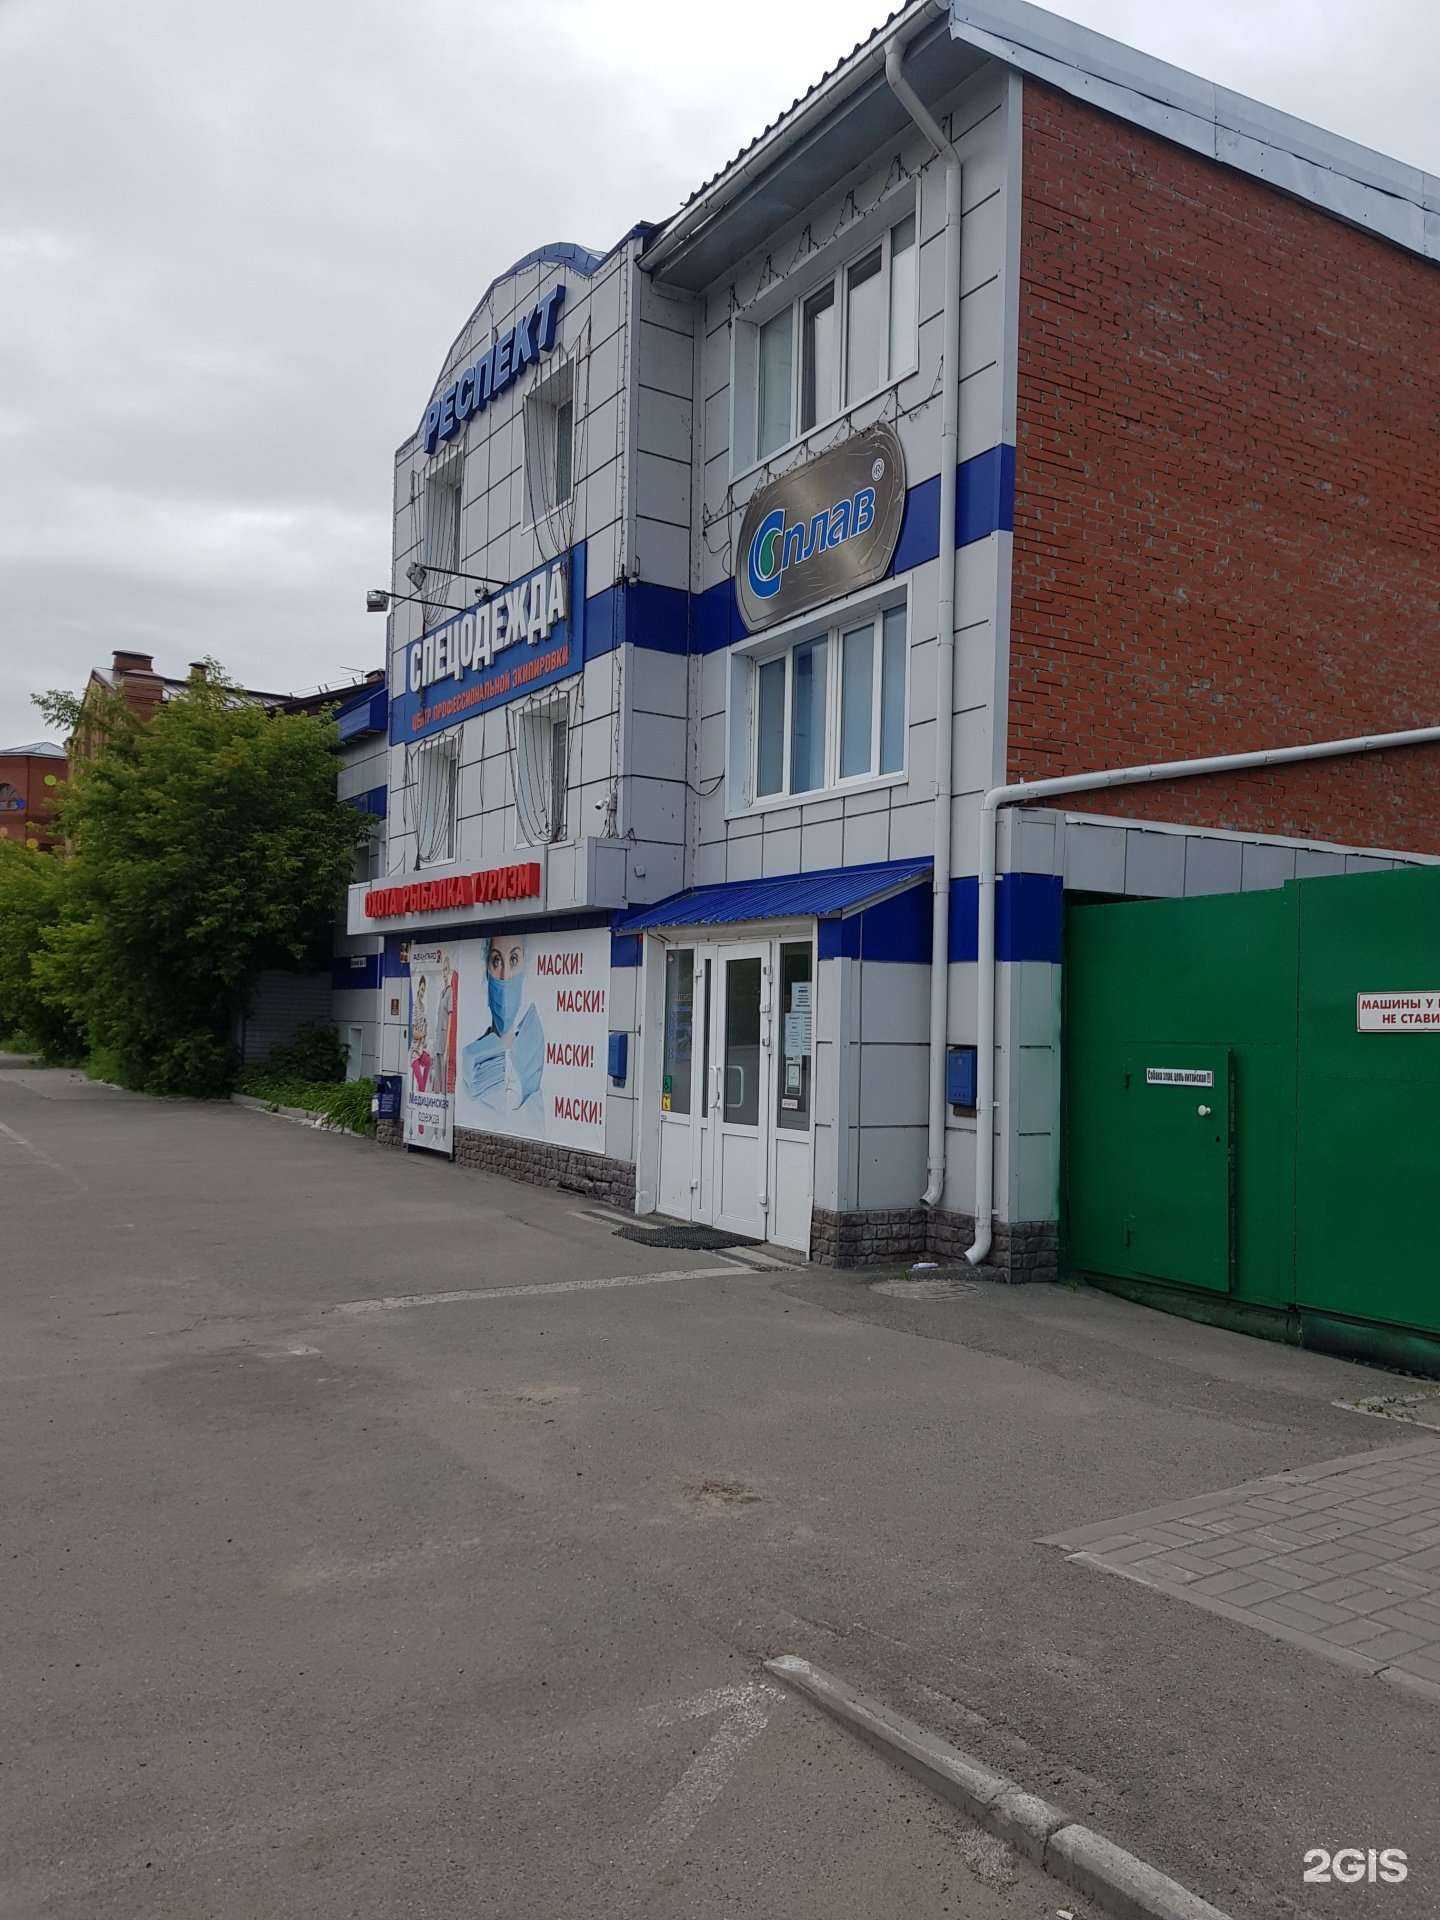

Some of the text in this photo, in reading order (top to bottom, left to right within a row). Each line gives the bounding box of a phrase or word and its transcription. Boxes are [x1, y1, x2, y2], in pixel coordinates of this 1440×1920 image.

[423, 284, 566, 454] РЕСПЕКТ
[748, 487, 876, 599] Сплав
[410, 562, 565, 693] СПЕЦОДЕЖДА
[411, 645, 569, 733] ЦЕНТР ПРОФЕССИОНАЛЬНОЙ ЭКИПИРОВКИ
[366, 864, 532, 918] ОХОТА РЫБАЛКА ТУРИЗМ
[537, 953, 583, 976] МАСКИ!
[557, 990, 605, 1013] МАСКИ!
[1361, 999, 1421, 1010] МАШИНЫ
[1425, 999, 1433, 1009] У
[1382, 1014, 1396, 1024] НЕ
[547, 1043, 594, 1068] МАСКИ!
[555, 1096, 602, 1125] МАСКИ!
